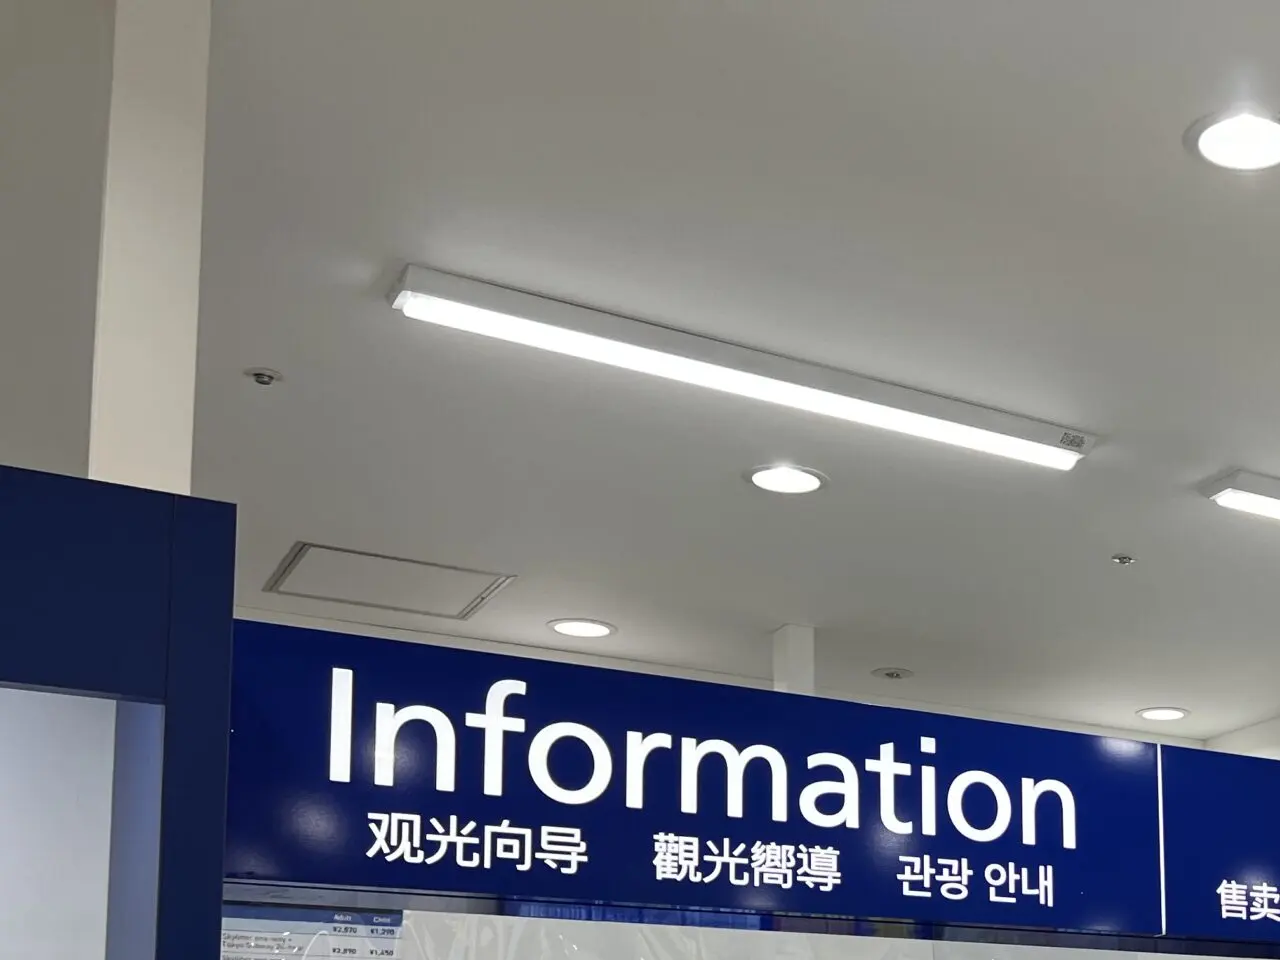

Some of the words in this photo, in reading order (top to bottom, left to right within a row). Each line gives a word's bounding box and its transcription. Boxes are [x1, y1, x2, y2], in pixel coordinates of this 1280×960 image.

[327, 666, 1078, 850] Information
[366, 811, 588, 875] 观光向导
[652, 833, 842, 893] 觀光嚮導
[895, 854, 974, 903] 관광
[983, 862, 1055, 907] 안내
